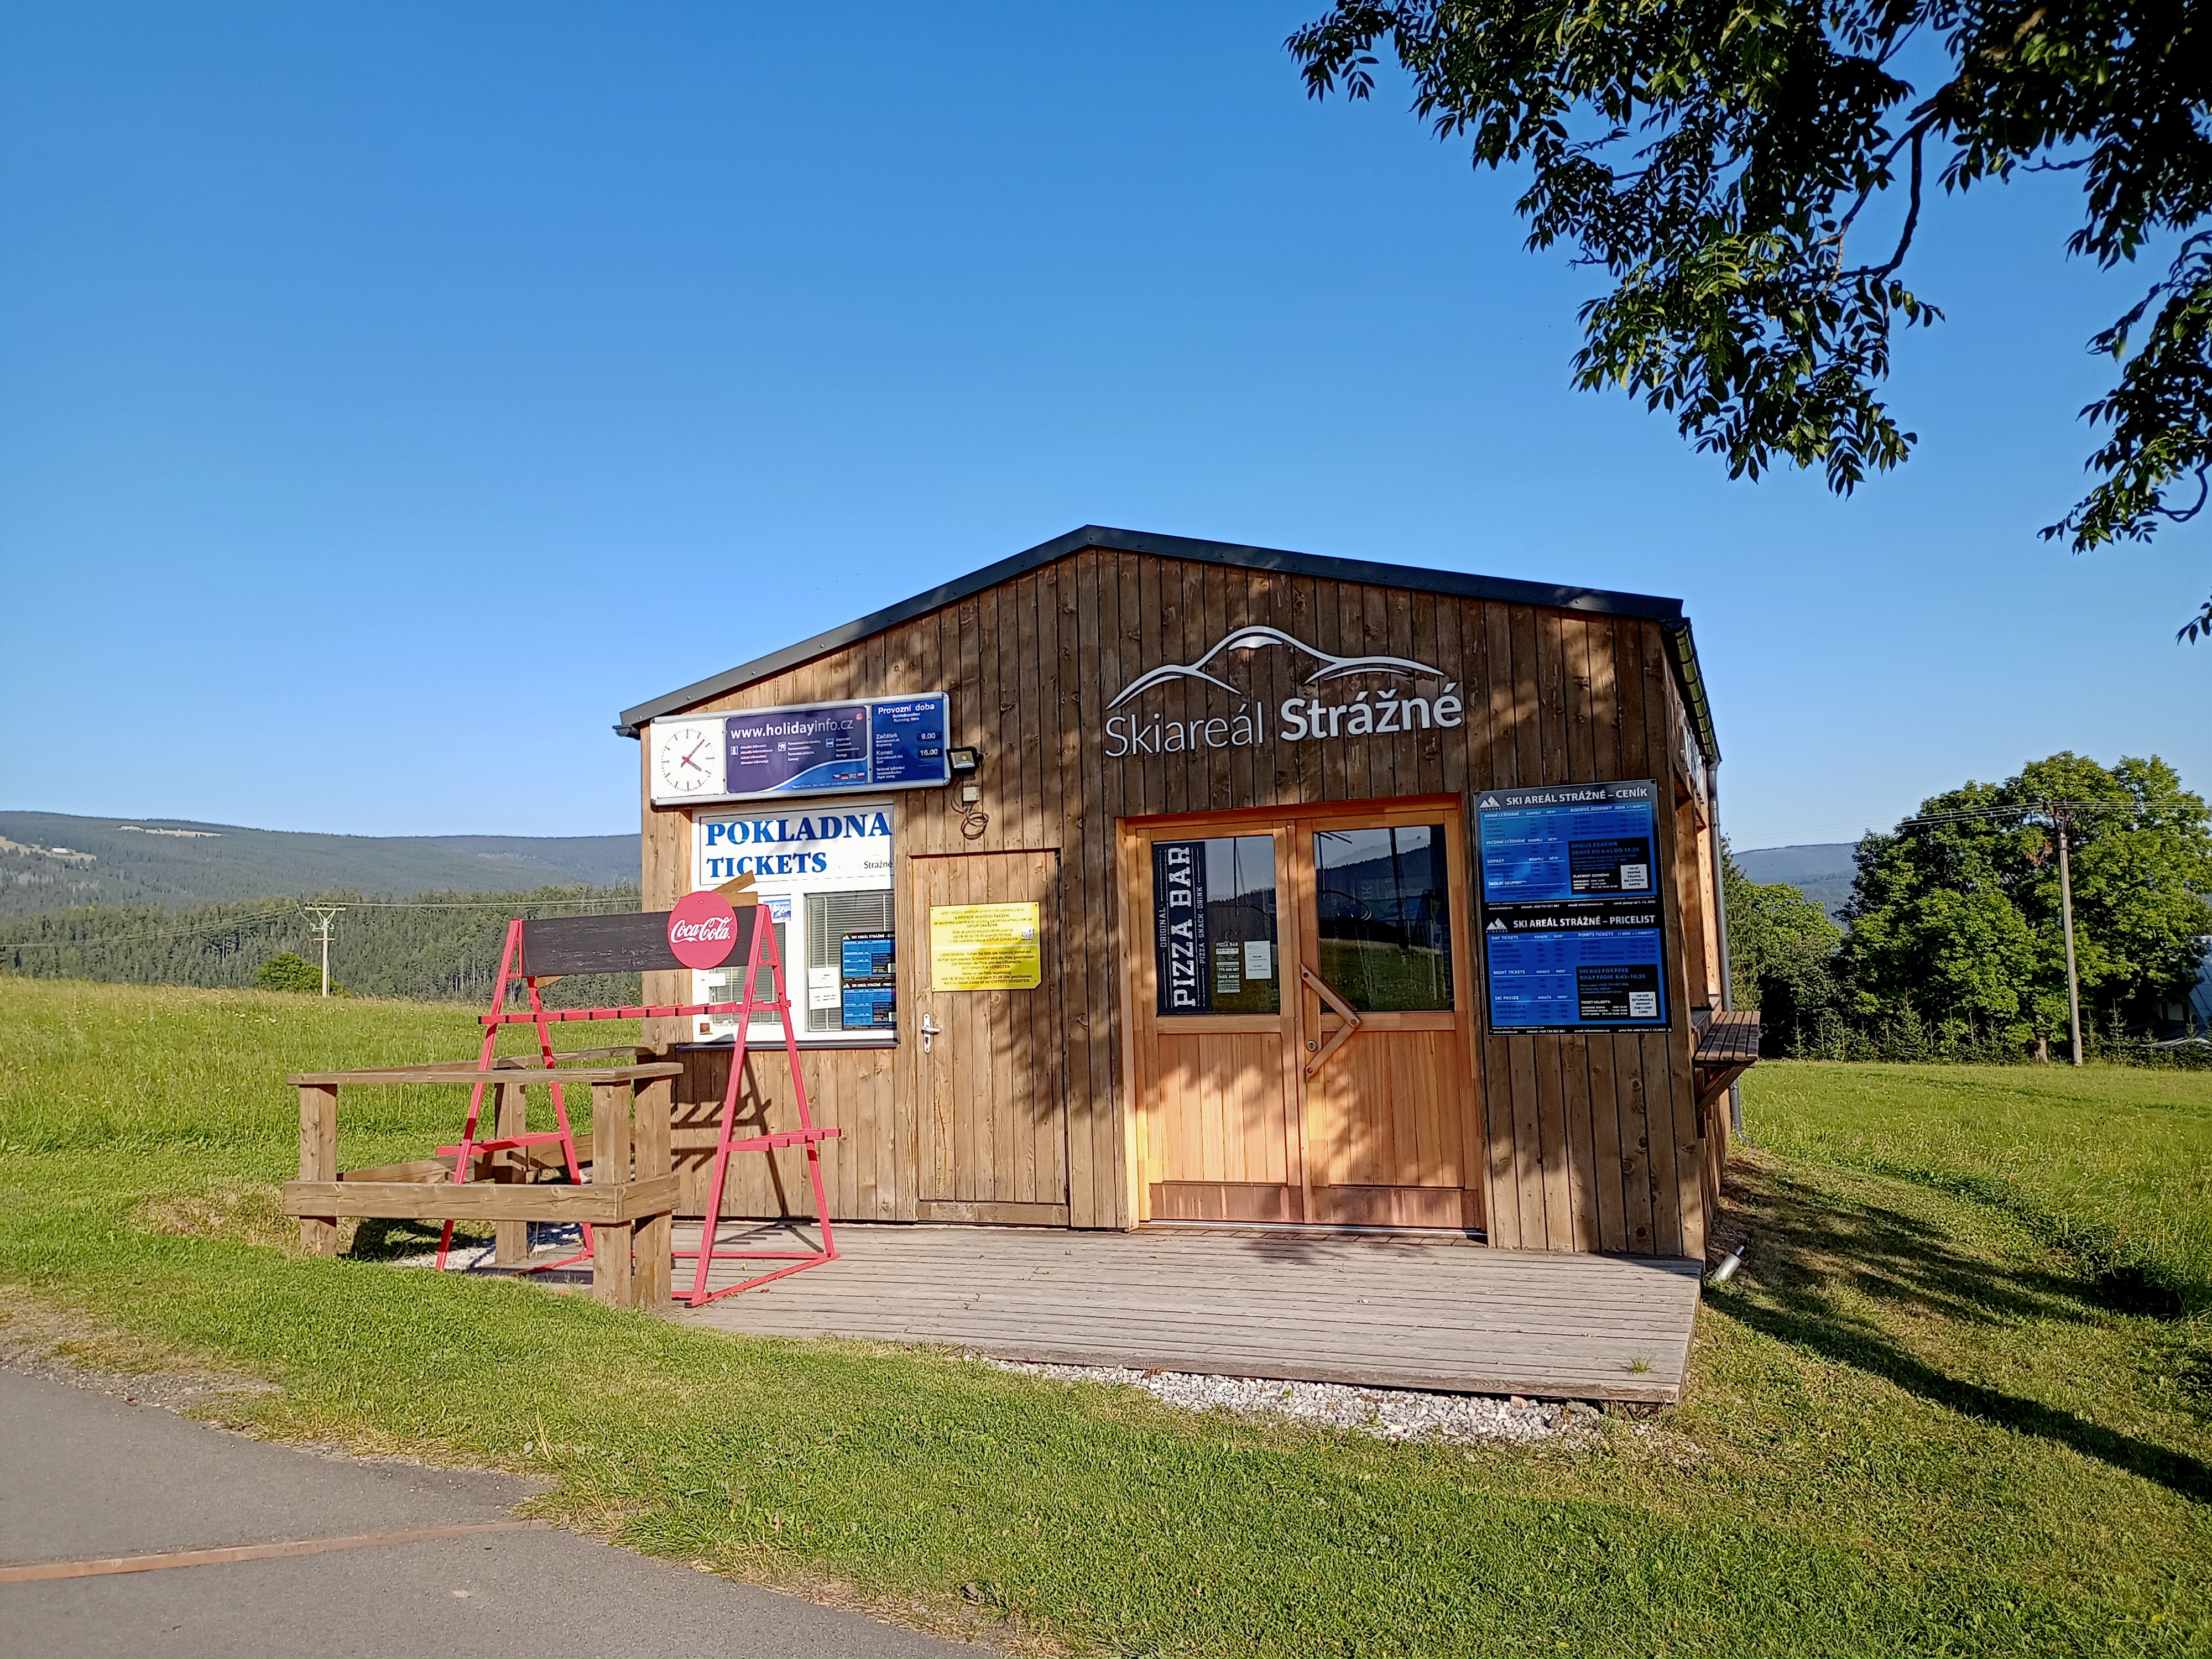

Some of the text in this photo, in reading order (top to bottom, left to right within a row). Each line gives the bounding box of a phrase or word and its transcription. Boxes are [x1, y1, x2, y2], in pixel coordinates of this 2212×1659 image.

[878, 704, 911, 714] Provozní
[1105, 682, 1463, 757] Skiareál Strážné
[731, 718, 853, 739] www.holidayinfo.cz
[1506, 796, 1522, 806] SKI
[1524, 793, 1557, 805] AREÁL
[1559, 789, 1606, 802] STRÁŽNÉ
[1616, 787, 1648, 798] CENÍK
[706, 812, 893, 846] POKLADNA
[706, 852, 827, 878] TICKETS
[670, 916, 733, 943] Coca-Cola
[1168, 847, 1196, 1007] PIZZA BAR
[1513, 920, 1527, 928] SKI
[1530, 917, 1558, 927] AREÁL
[1560, 915, 1601, 926] STRÁŽNÉ
[1610, 915, 1655, 925] PRICELIST
